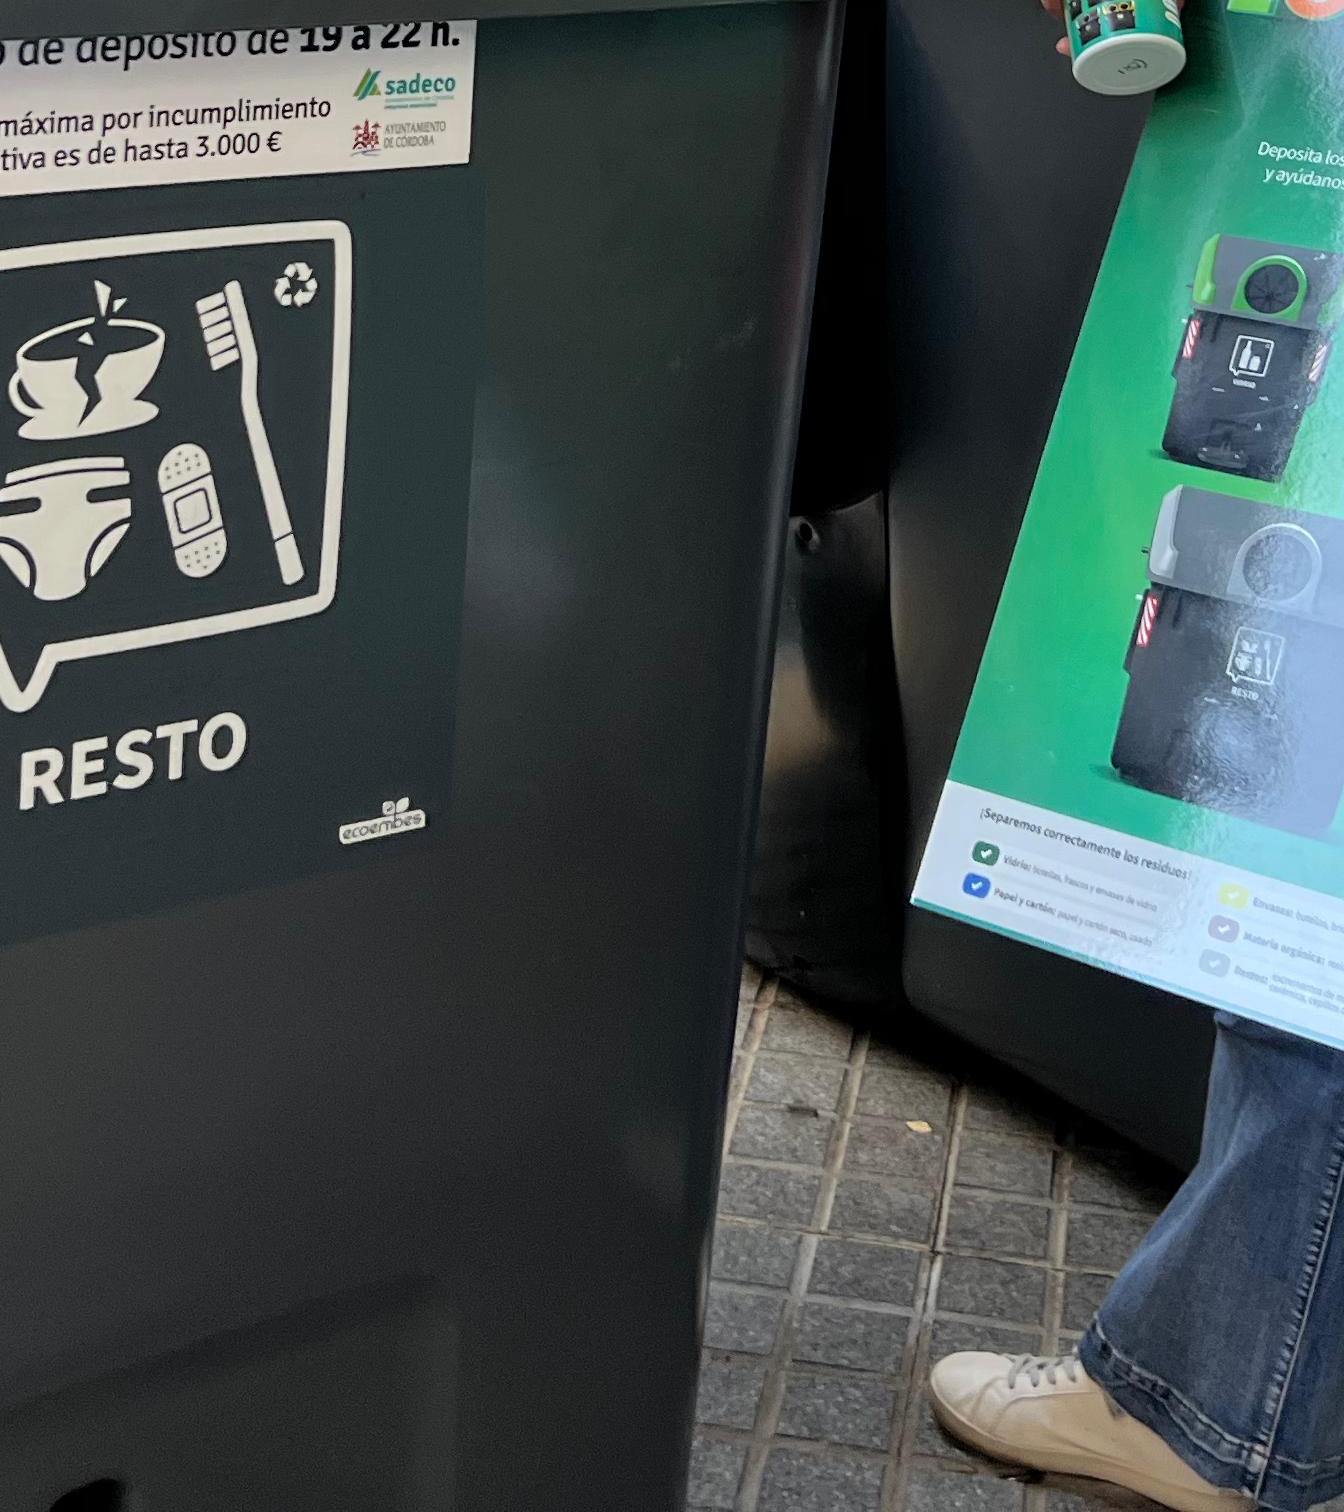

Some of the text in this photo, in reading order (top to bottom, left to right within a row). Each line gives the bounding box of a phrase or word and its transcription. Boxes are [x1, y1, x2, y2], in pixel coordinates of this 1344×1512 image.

[299, 25, 343, 53] 19
[351, 25, 372, 50] a
[380, 22, 422, 50] 22
[384, 72, 456, 95] sadeco
[102, 109, 143, 137] por
[149, 97, 331, 129] incumplimiento
[55, 148, 81, 168] es
[87, 140, 117, 165] de
[124, 137, 189, 163] hasta
[196, 133, 261, 158] 3.000
[266, 131, 283, 153] €
[1257, 141, 1323, 165] Deposita
[1262, 168, 1274, 184] y
[18, 711, 248, 811] RESTO
[342, 813, 422, 840] ecoembes
[1043, 825, 1122, 859] correctamente
[1123, 848, 1140, 865] los
